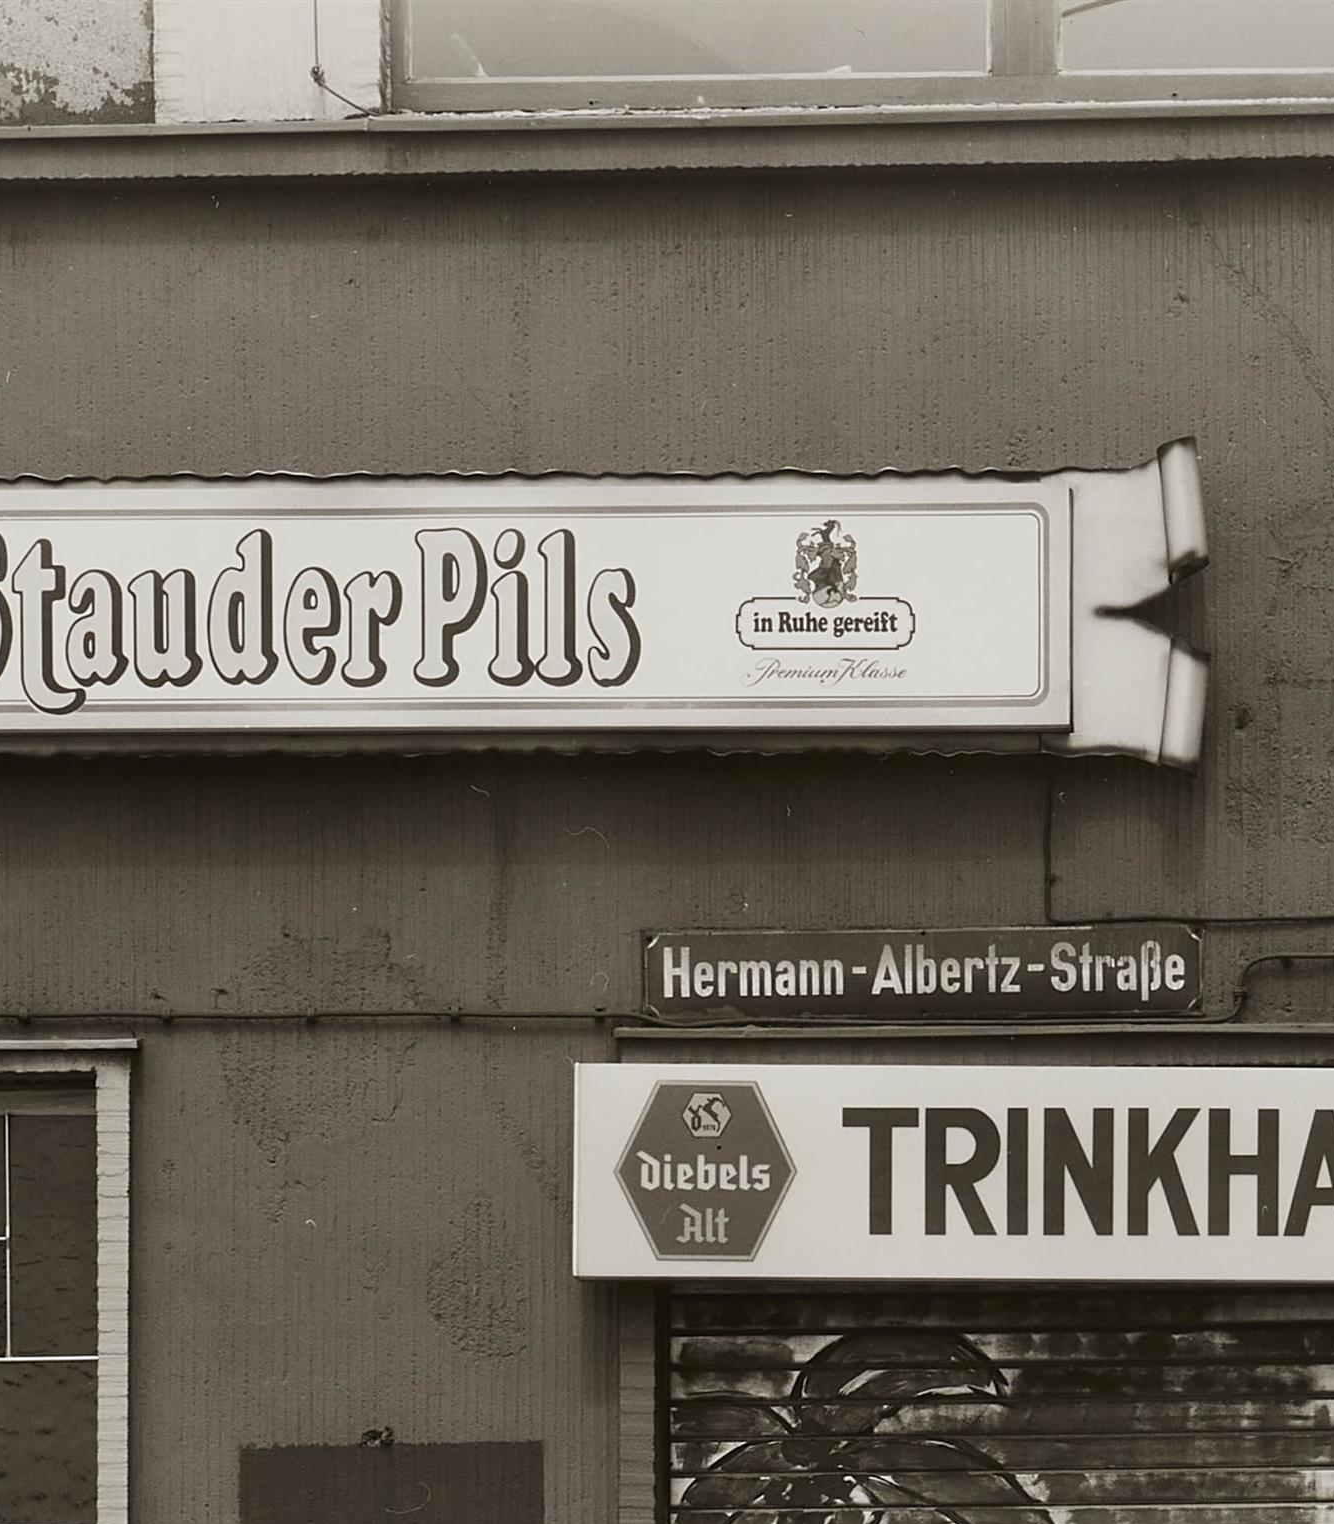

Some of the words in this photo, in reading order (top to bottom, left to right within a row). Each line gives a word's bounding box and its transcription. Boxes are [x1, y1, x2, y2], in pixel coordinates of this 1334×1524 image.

[414, 527, 641, 687] Pils
[753, 612, 773, 633] in
[778, 612, 828, 632] Ruhe
[833, 611, 898, 637] gereift
[663, 941, 1186, 1002] Hermann-Albertz-Straße
[675, 1203, 730, 1243] Alt
